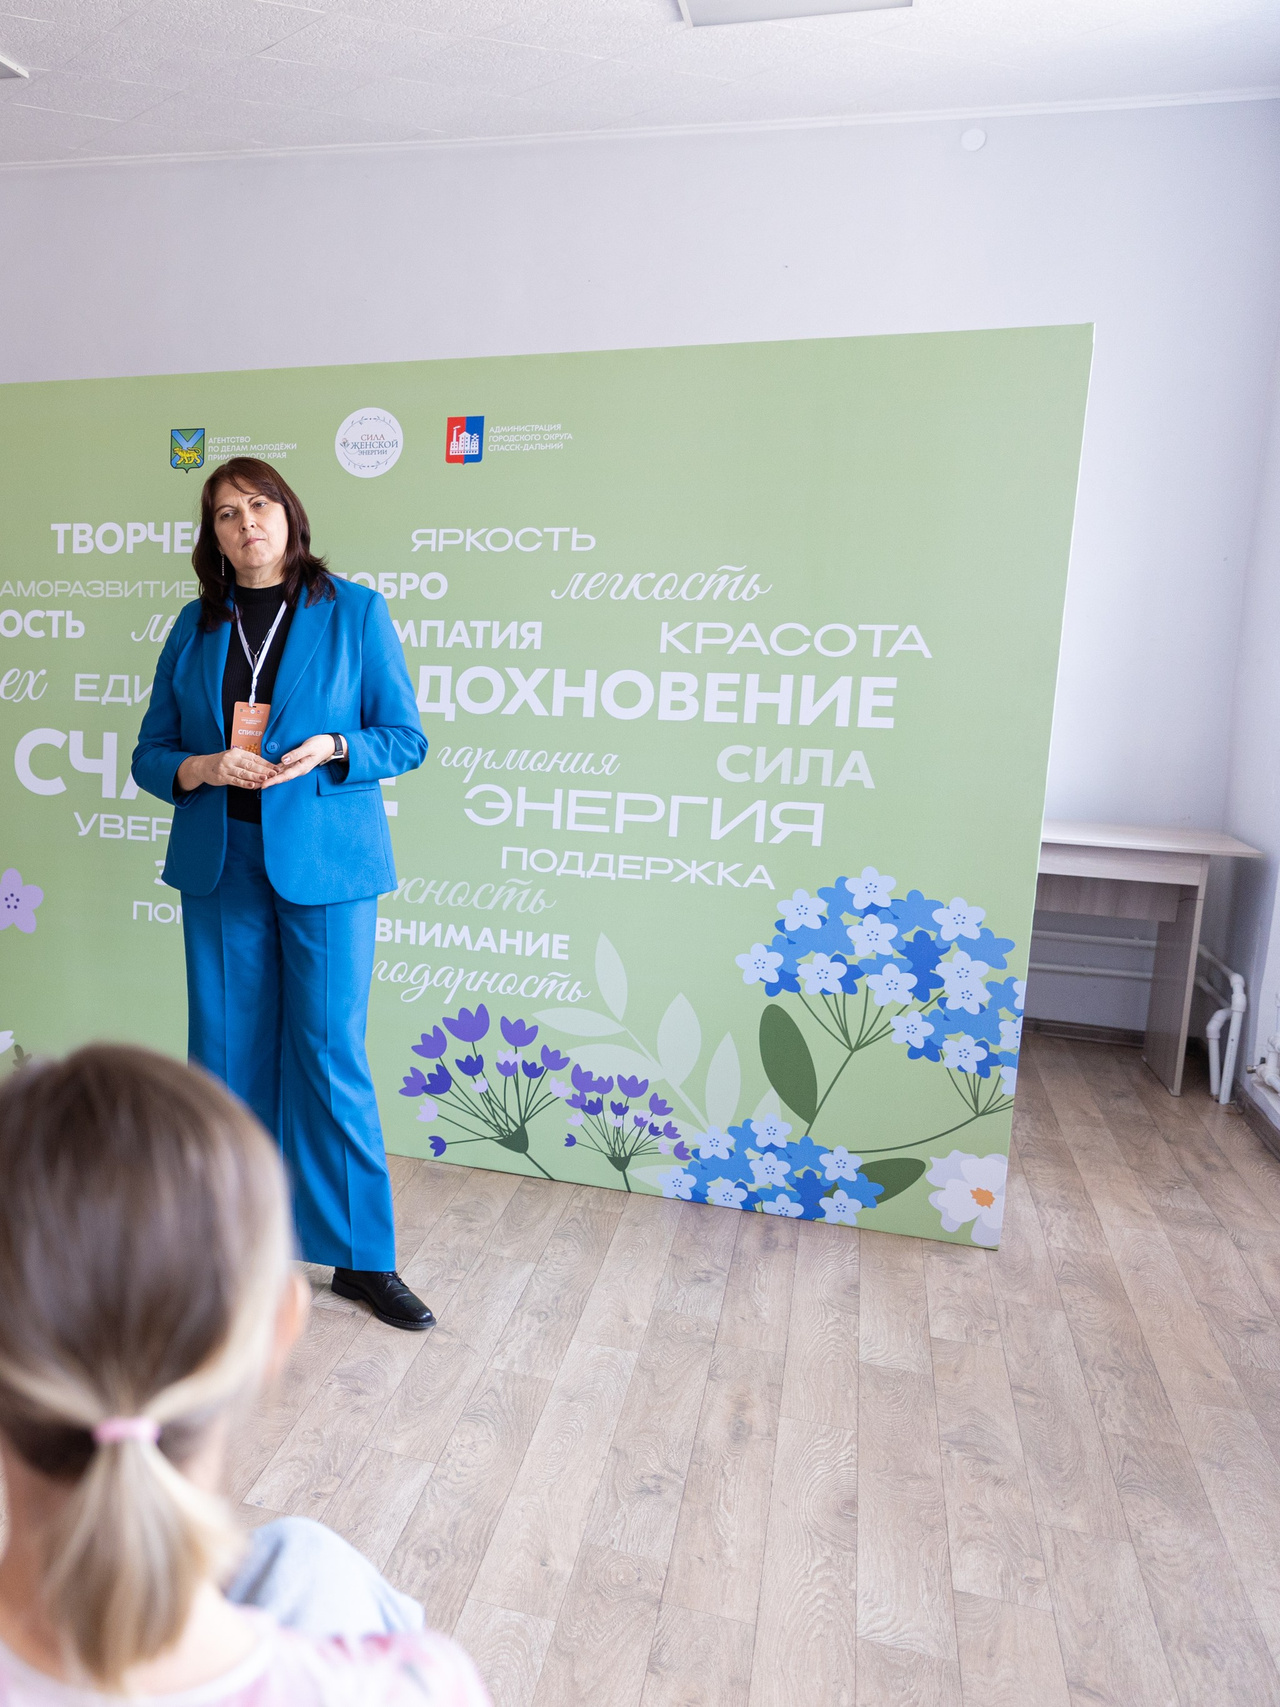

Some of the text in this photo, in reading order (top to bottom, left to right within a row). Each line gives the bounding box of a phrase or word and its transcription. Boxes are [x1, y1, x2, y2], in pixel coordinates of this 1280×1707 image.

[208, 436, 250, 444] АГЕНТСТВО
[488, 432, 573, 442] ГОРОДСКОГО ОКРУГА
[489, 424, 562, 434] АДМИНИСТРАЦИЯ
[221, 445, 248, 453] ДЕЛАМ
[250, 442, 297, 451] МОЛОДЁЖИ
[350, 439, 398, 450] ЖЕНСКОЙ
[488, 442, 564, 452] СПАССК-ДАЛЬНИЙ
[51, 522, 202, 554] ТВОРЧЕ
[411, 527, 596, 552] ЯРКОСТЬ
[333, 572, 448, 600] ОБРО
[551, 564, 772, 602] легкость
[660, 622, 933, 659] КРАСОТА
[416, 665, 898, 729] ДОХНОВЕНИЕ
[238, 729, 262, 737] СПИКЕР
[437, 746, 620, 783] гармония
[716, 744, 876, 789] СИЛА
[464, 784, 825, 847] ЭНЕРГИЯ
[500, 846, 775, 890] ПОДДЕРЖКА
[375, 917, 570, 960] ВНИМАНИЕ
